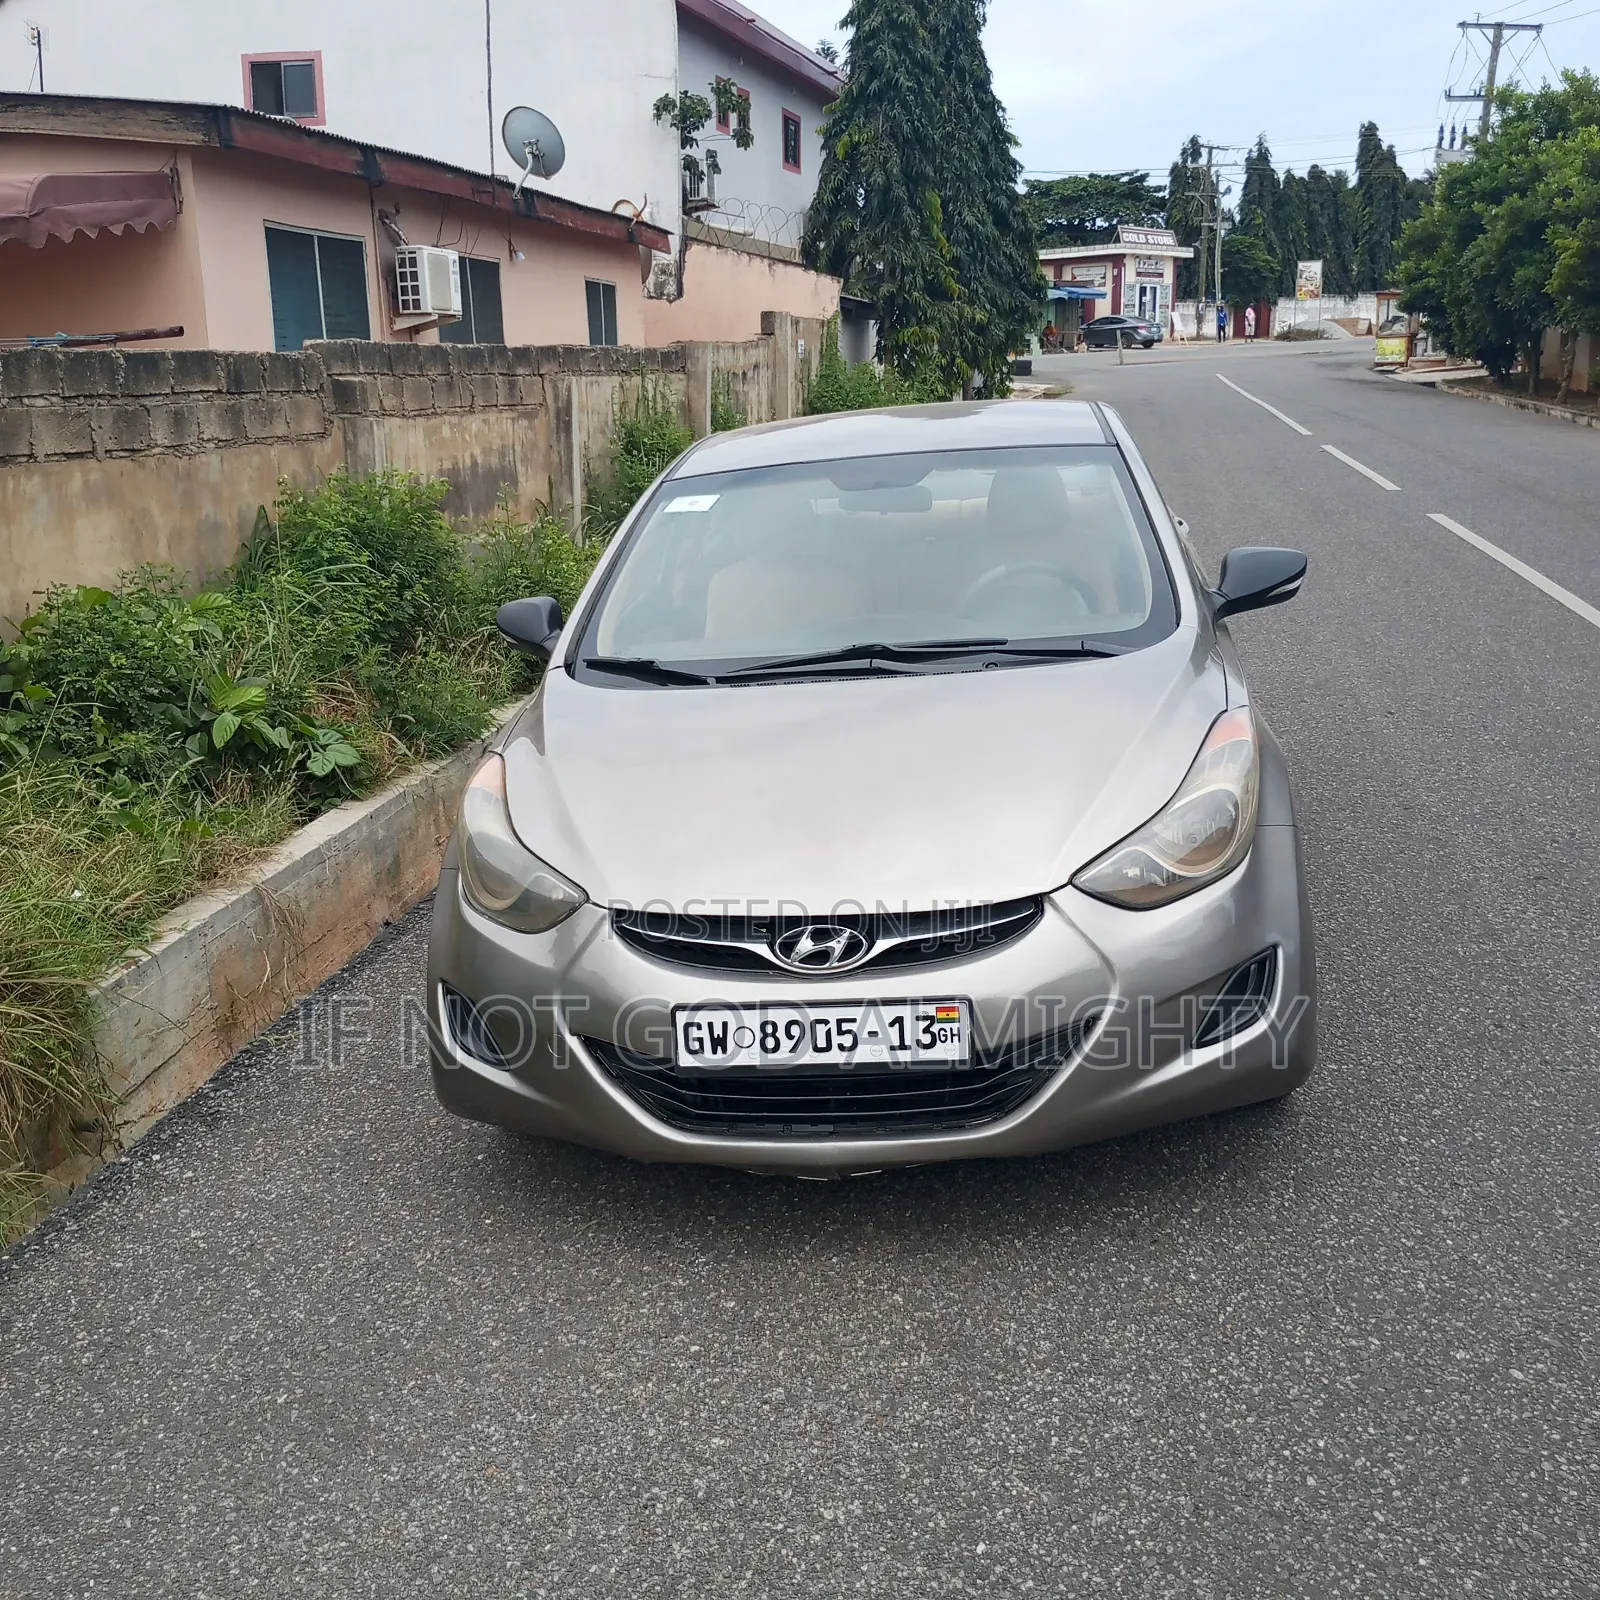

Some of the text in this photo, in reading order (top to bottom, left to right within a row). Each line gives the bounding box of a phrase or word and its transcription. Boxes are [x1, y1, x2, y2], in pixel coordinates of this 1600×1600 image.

[1122, 232, 1175, 246] COLD STORE
[682, 1015, 938, 1055] GW 8905-13
[937, 1026, 961, 1044] GH
